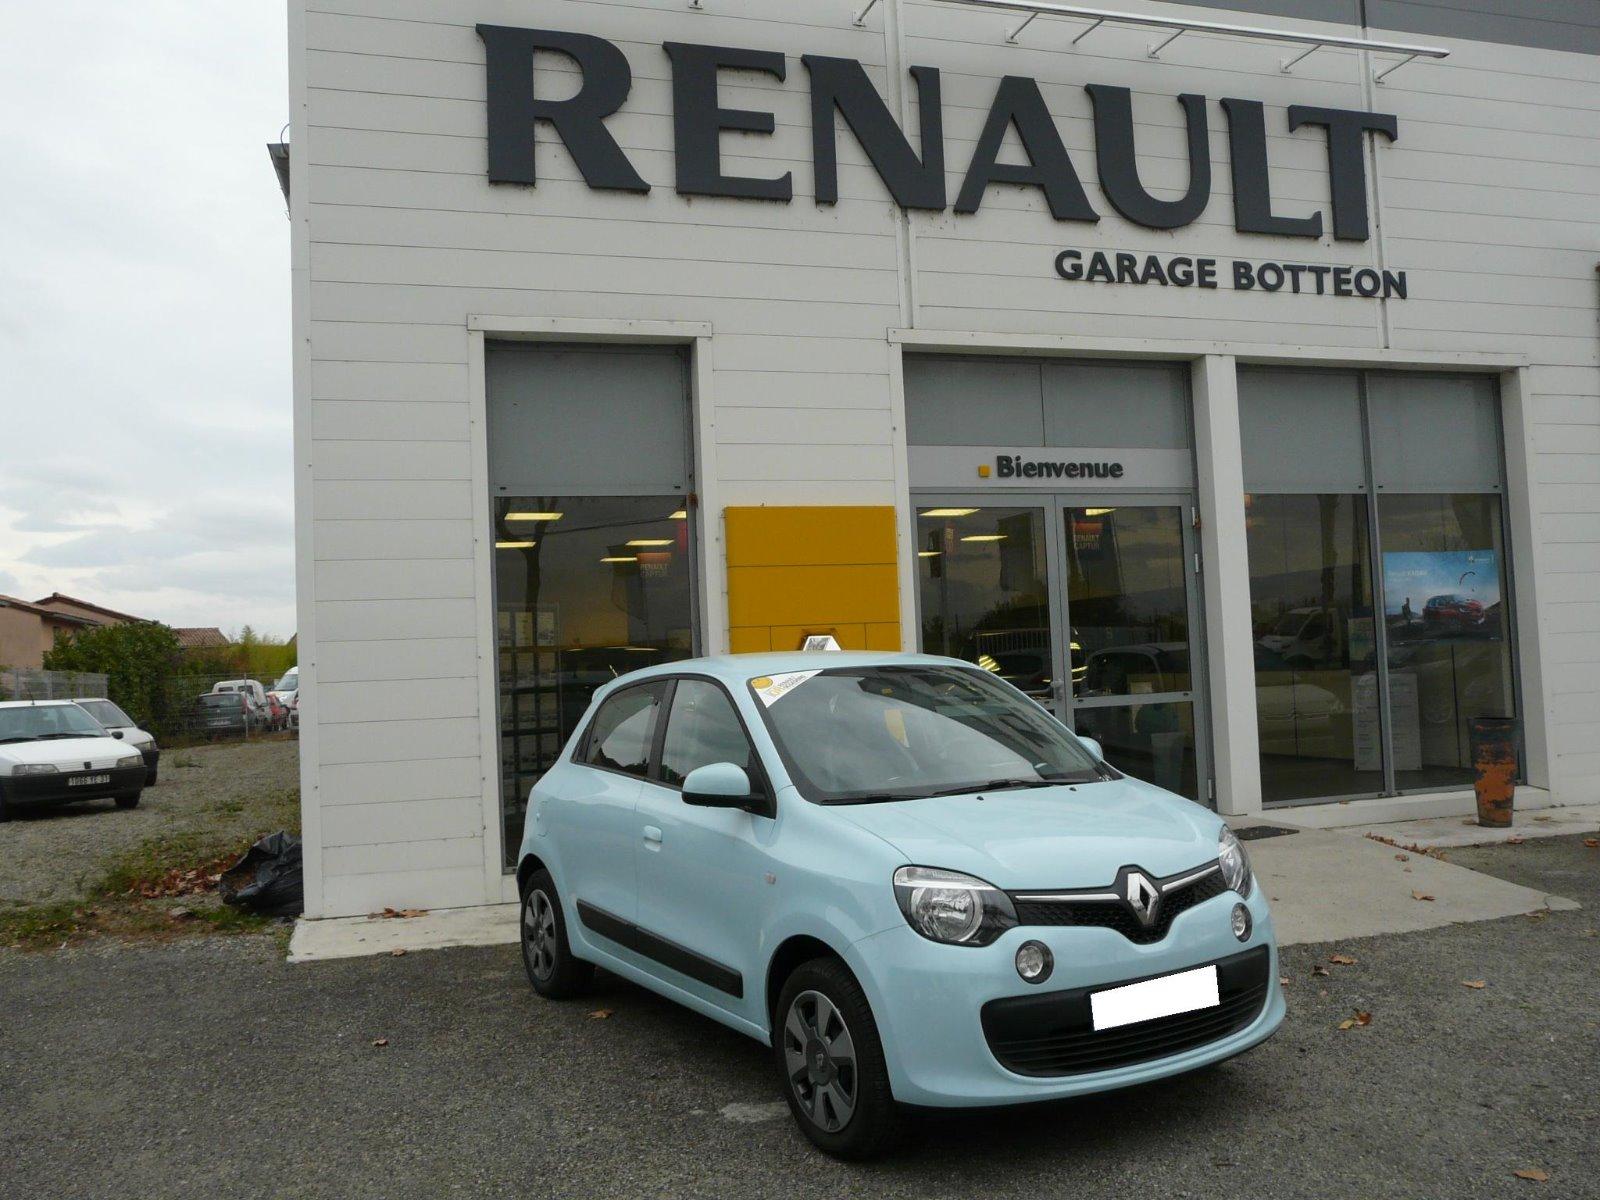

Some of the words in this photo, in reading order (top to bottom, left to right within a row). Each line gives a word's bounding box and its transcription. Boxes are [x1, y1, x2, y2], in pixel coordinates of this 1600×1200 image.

[476, 23, 1397, 242] RENAULT
[1054, 249, 1218, 289] GARAGE
[1232, 260, 1407, 300] BOTTEON
[996, 454, 1124, 479] Bienvenue
